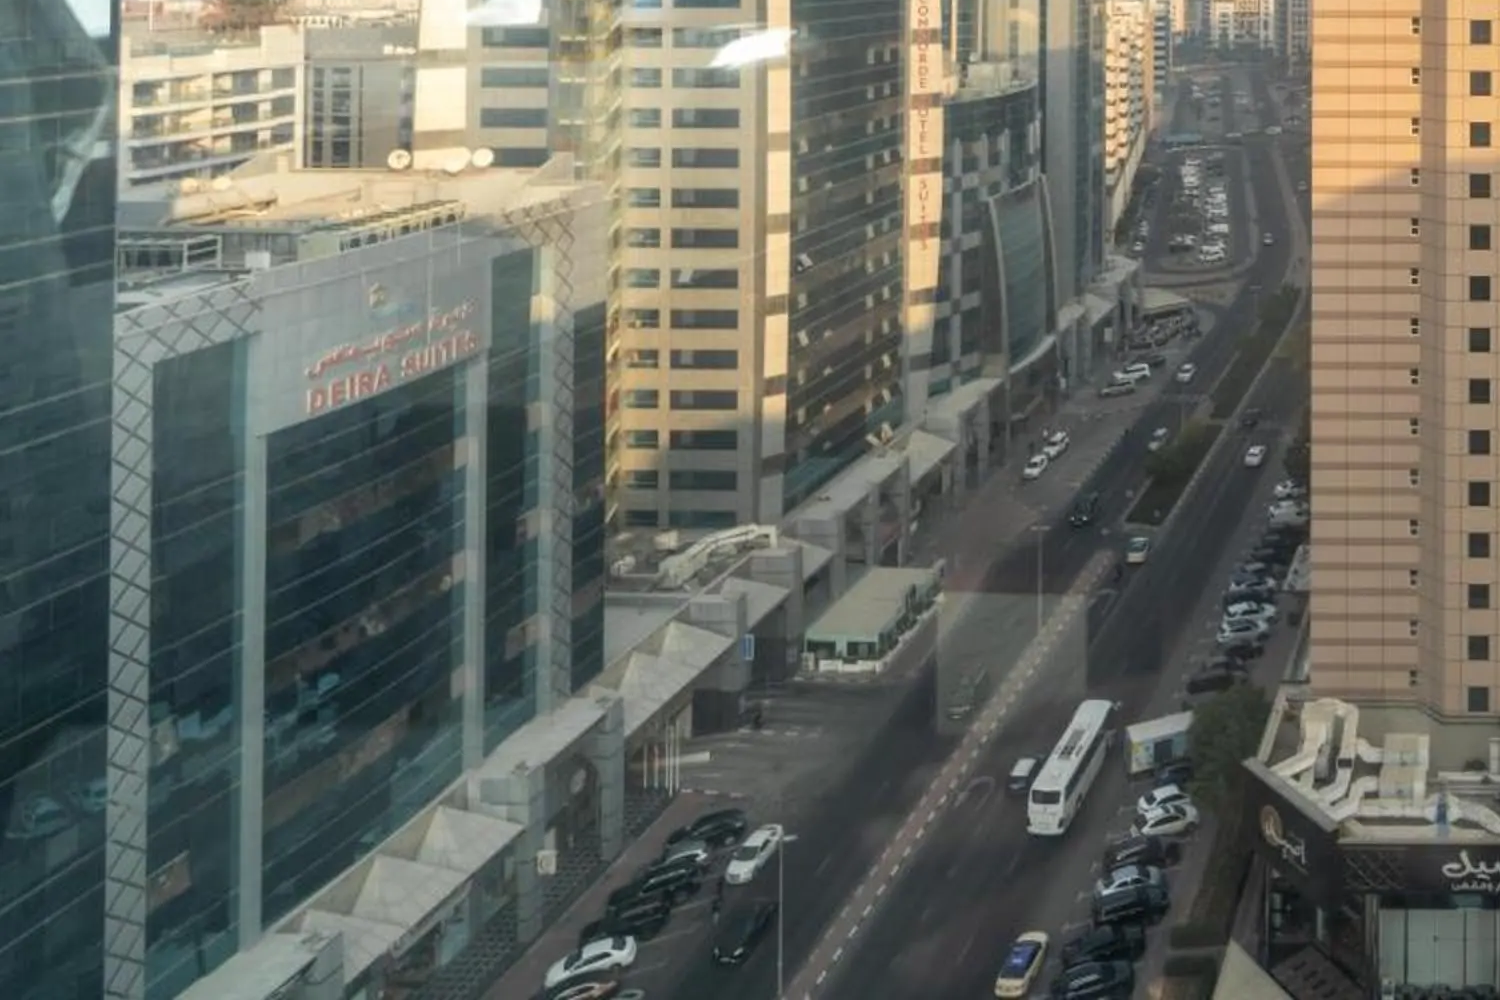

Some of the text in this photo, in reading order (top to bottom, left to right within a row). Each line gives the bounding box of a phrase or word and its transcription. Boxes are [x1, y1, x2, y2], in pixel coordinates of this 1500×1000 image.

[917, 96, 929, 155] OTEL
[917, 180, 929, 251] SUITS
[306, 329, 479, 415] DEIRA SUITES
